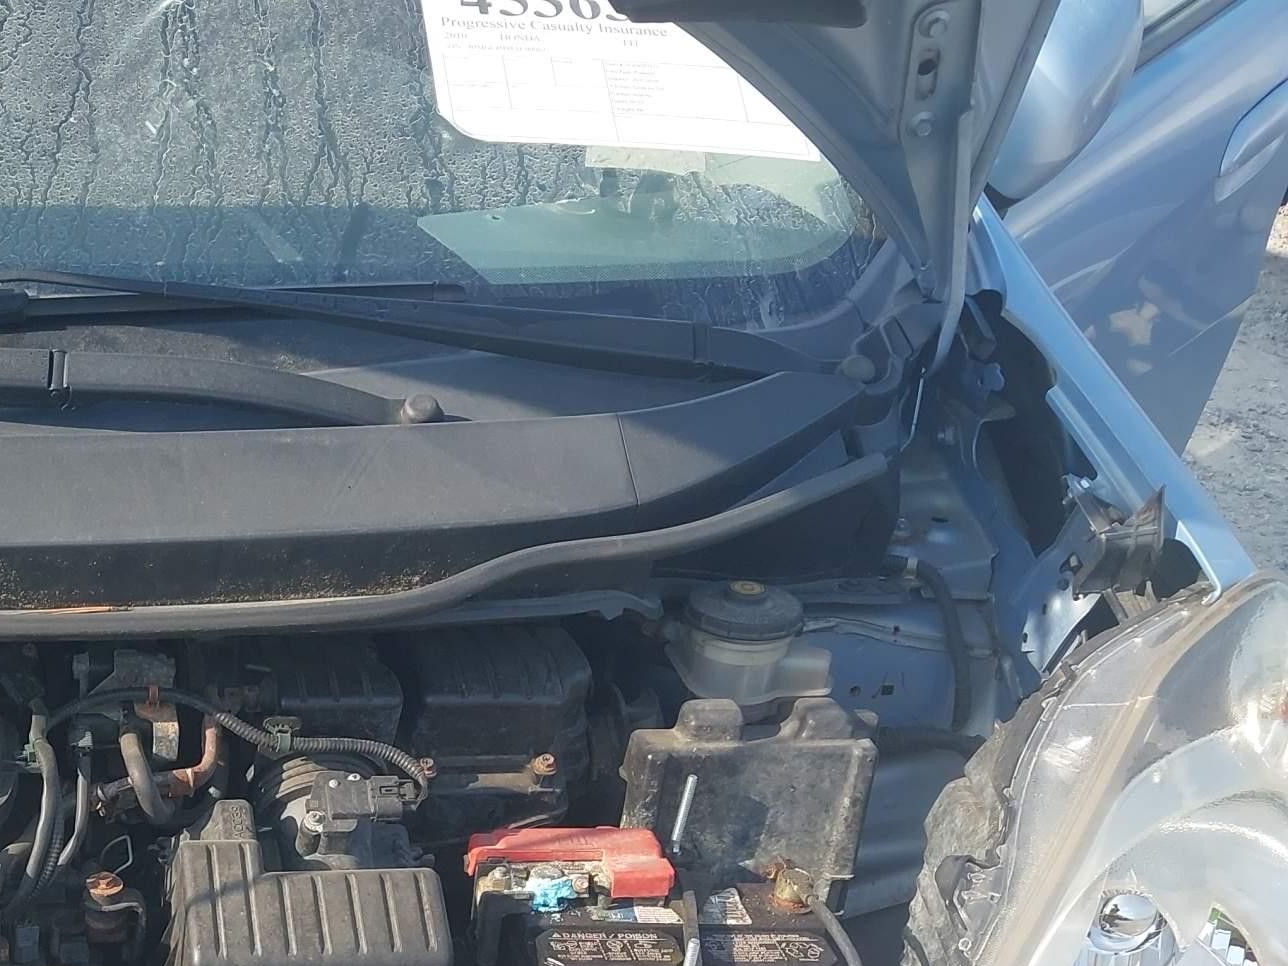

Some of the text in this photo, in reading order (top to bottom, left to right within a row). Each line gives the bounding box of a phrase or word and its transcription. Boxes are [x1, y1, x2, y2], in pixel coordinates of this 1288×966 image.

[441, 16, 669, 38] Progressive Casualty Insurance
